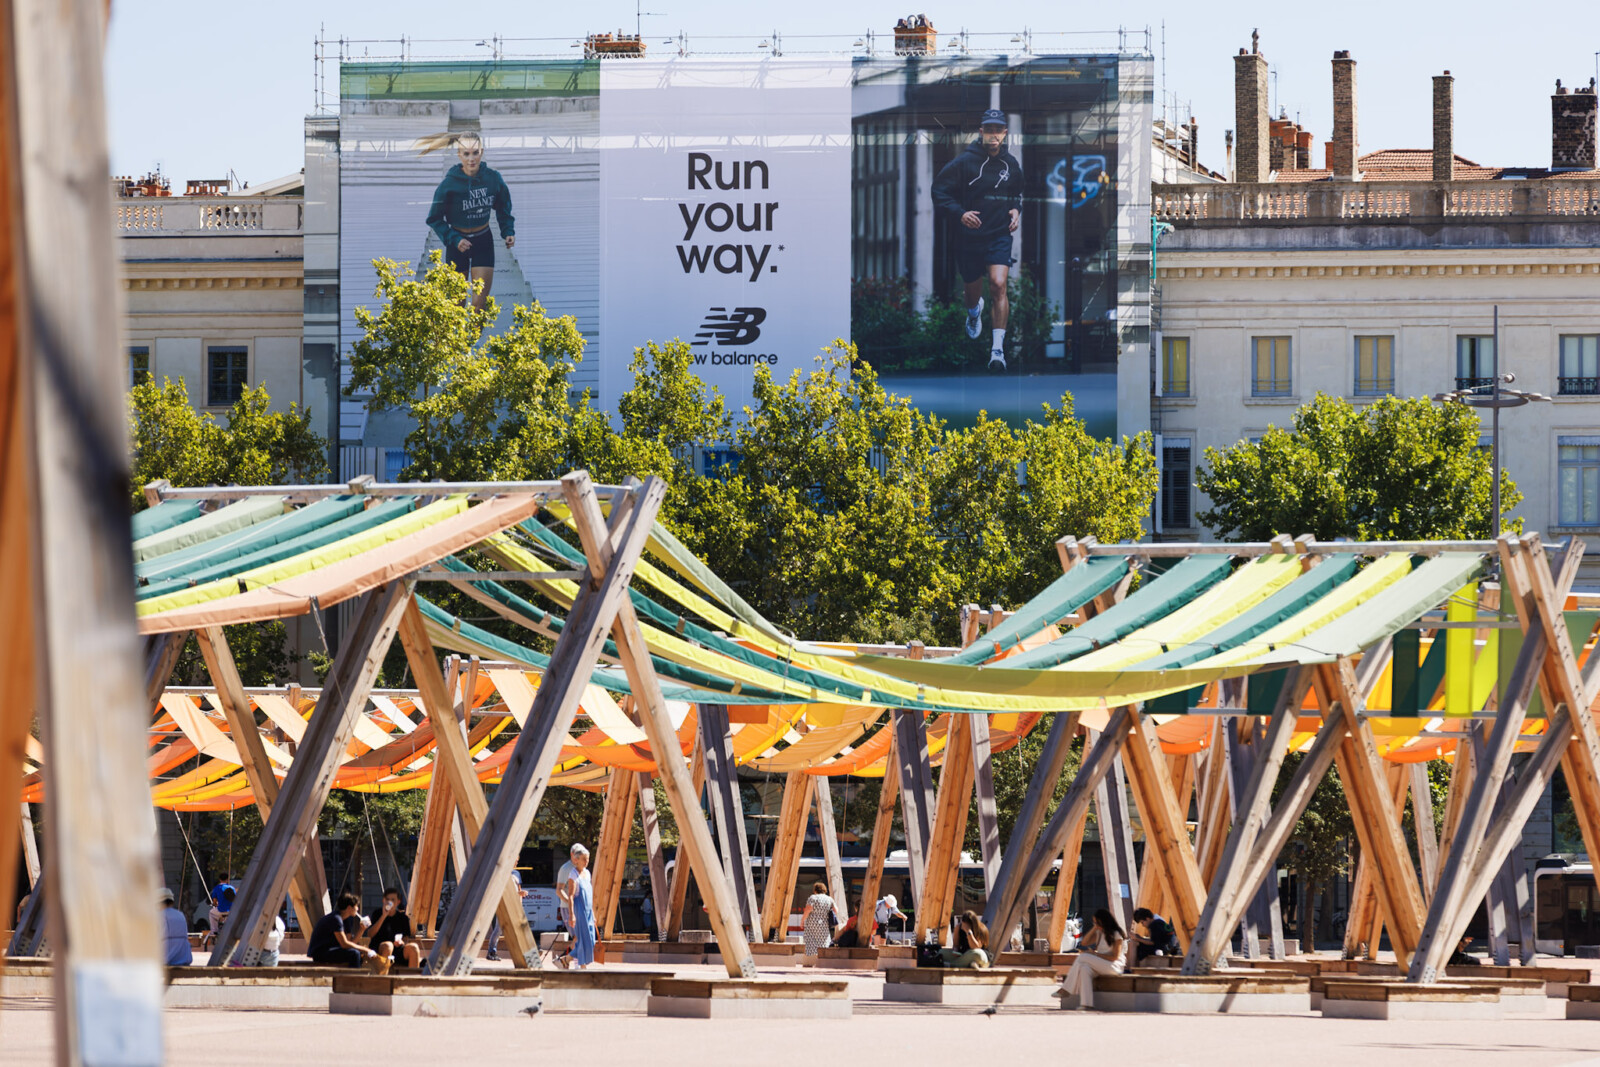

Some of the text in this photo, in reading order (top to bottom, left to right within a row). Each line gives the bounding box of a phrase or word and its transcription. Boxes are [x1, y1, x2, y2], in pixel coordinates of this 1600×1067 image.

[688, 152, 769, 190] Run
[469, 187, 488, 200] NEW
[678, 202, 779, 241] your
[711, 351, 778, 366] balance
